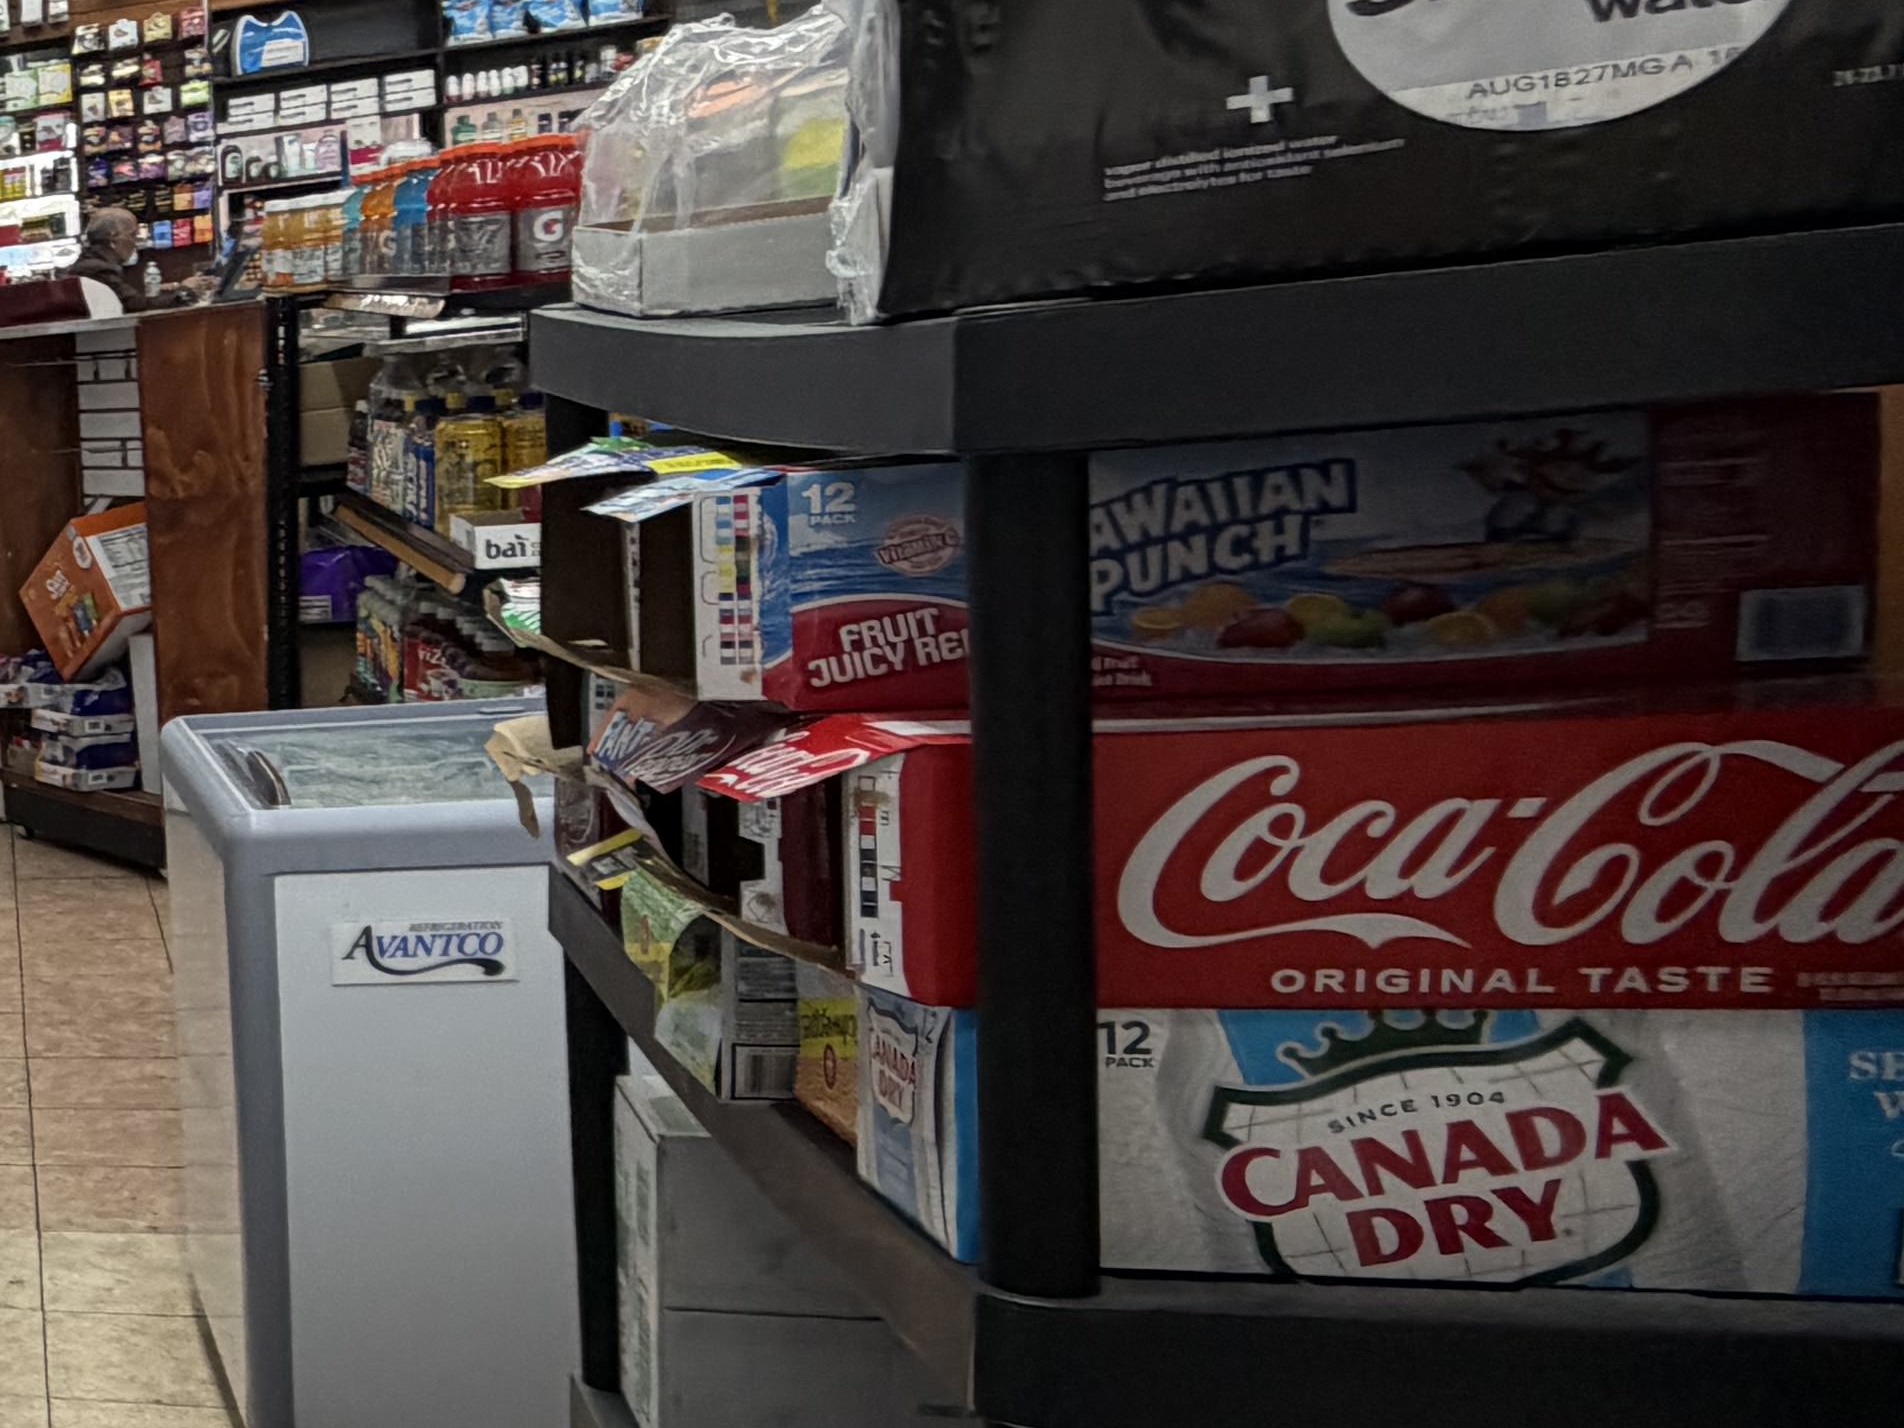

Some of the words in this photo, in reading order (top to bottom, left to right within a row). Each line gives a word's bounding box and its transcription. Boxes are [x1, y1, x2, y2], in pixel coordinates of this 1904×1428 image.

[533, 210, 564, 244] G
[802, 481, 856, 515] 12
[809, 512, 856, 527] PACK
[1090, 456, 1357, 558] AWAIIAN
[1090, 514, 1309, 616] PUNCH
[840, 607, 940, 653] FRUIT
[808, 639, 904, 690] JUICY
[1116, 739, 1904, 950] Coca-Cola
[342, 925, 505, 964] AVANTCO
[1271, 967, 1555, 995] ORIGINAL
[1583, 965, 1774, 994] TASTE
[1097, 1021, 1151, 1057] 12
[1104, 1055, 1154, 1069] PACK
[1328, 1098, 1416, 1135] SINCE
[1431, 1090, 1507, 1110] 1904
[1220, 1093, 1668, 1217] CANADA
[1348, 1178, 1563, 1269] DRY
